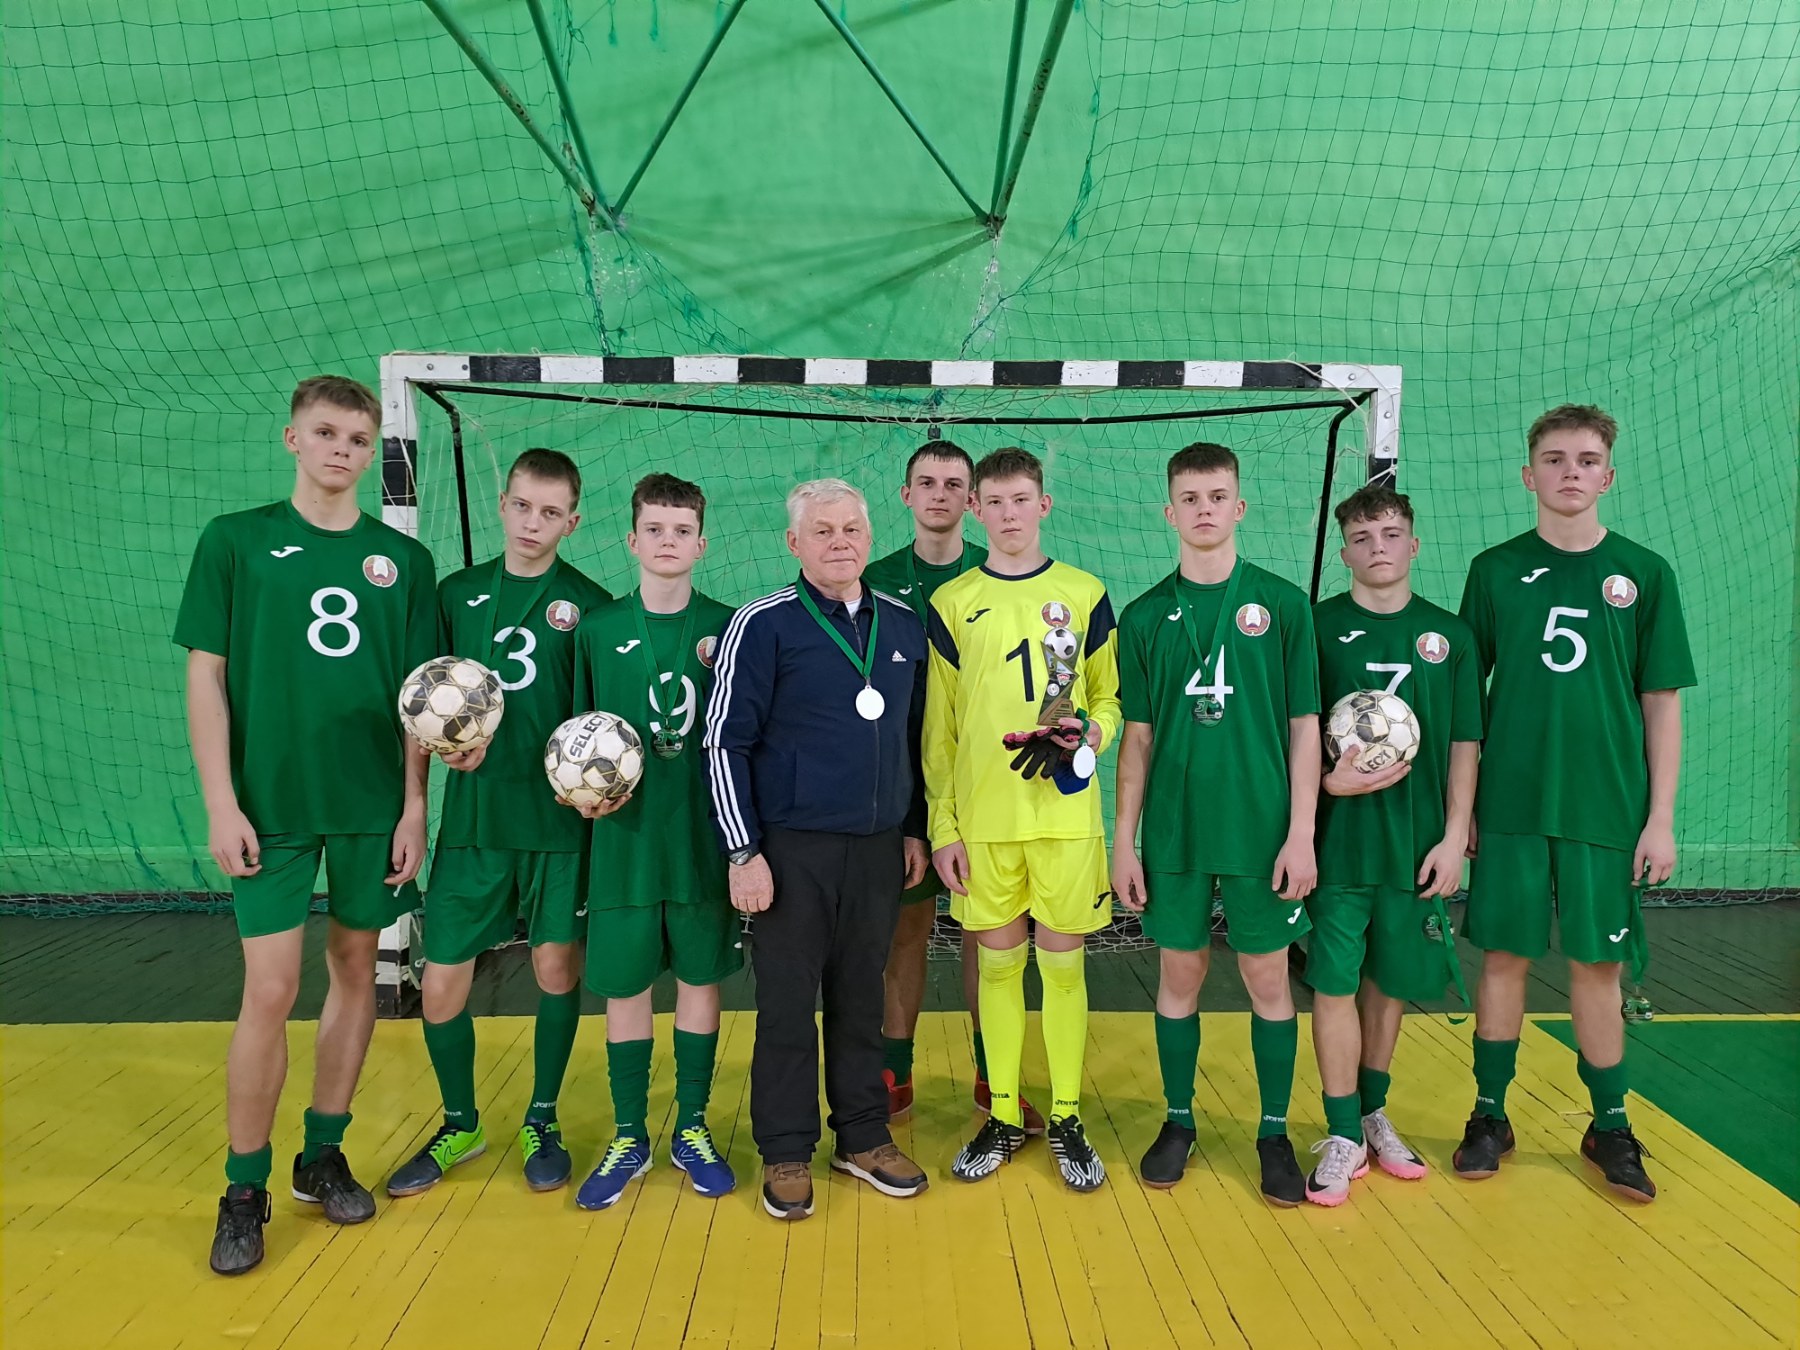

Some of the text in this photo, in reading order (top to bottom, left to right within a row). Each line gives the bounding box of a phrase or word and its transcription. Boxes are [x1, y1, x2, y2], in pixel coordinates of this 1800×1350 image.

[306, 586, 361, 658] 8
[1541, 606, 1589, 673] 5
[492, 626, 537, 691] 3
[1005, 638, 1035, 702] 1
[1184, 645, 1234, 709] 4
[1365, 662, 1412, 694] 7
[569, 714, 608, 758] SELECT
[648, 671, 697, 737] 9
[1358, 749, 1392, 774] LECT
